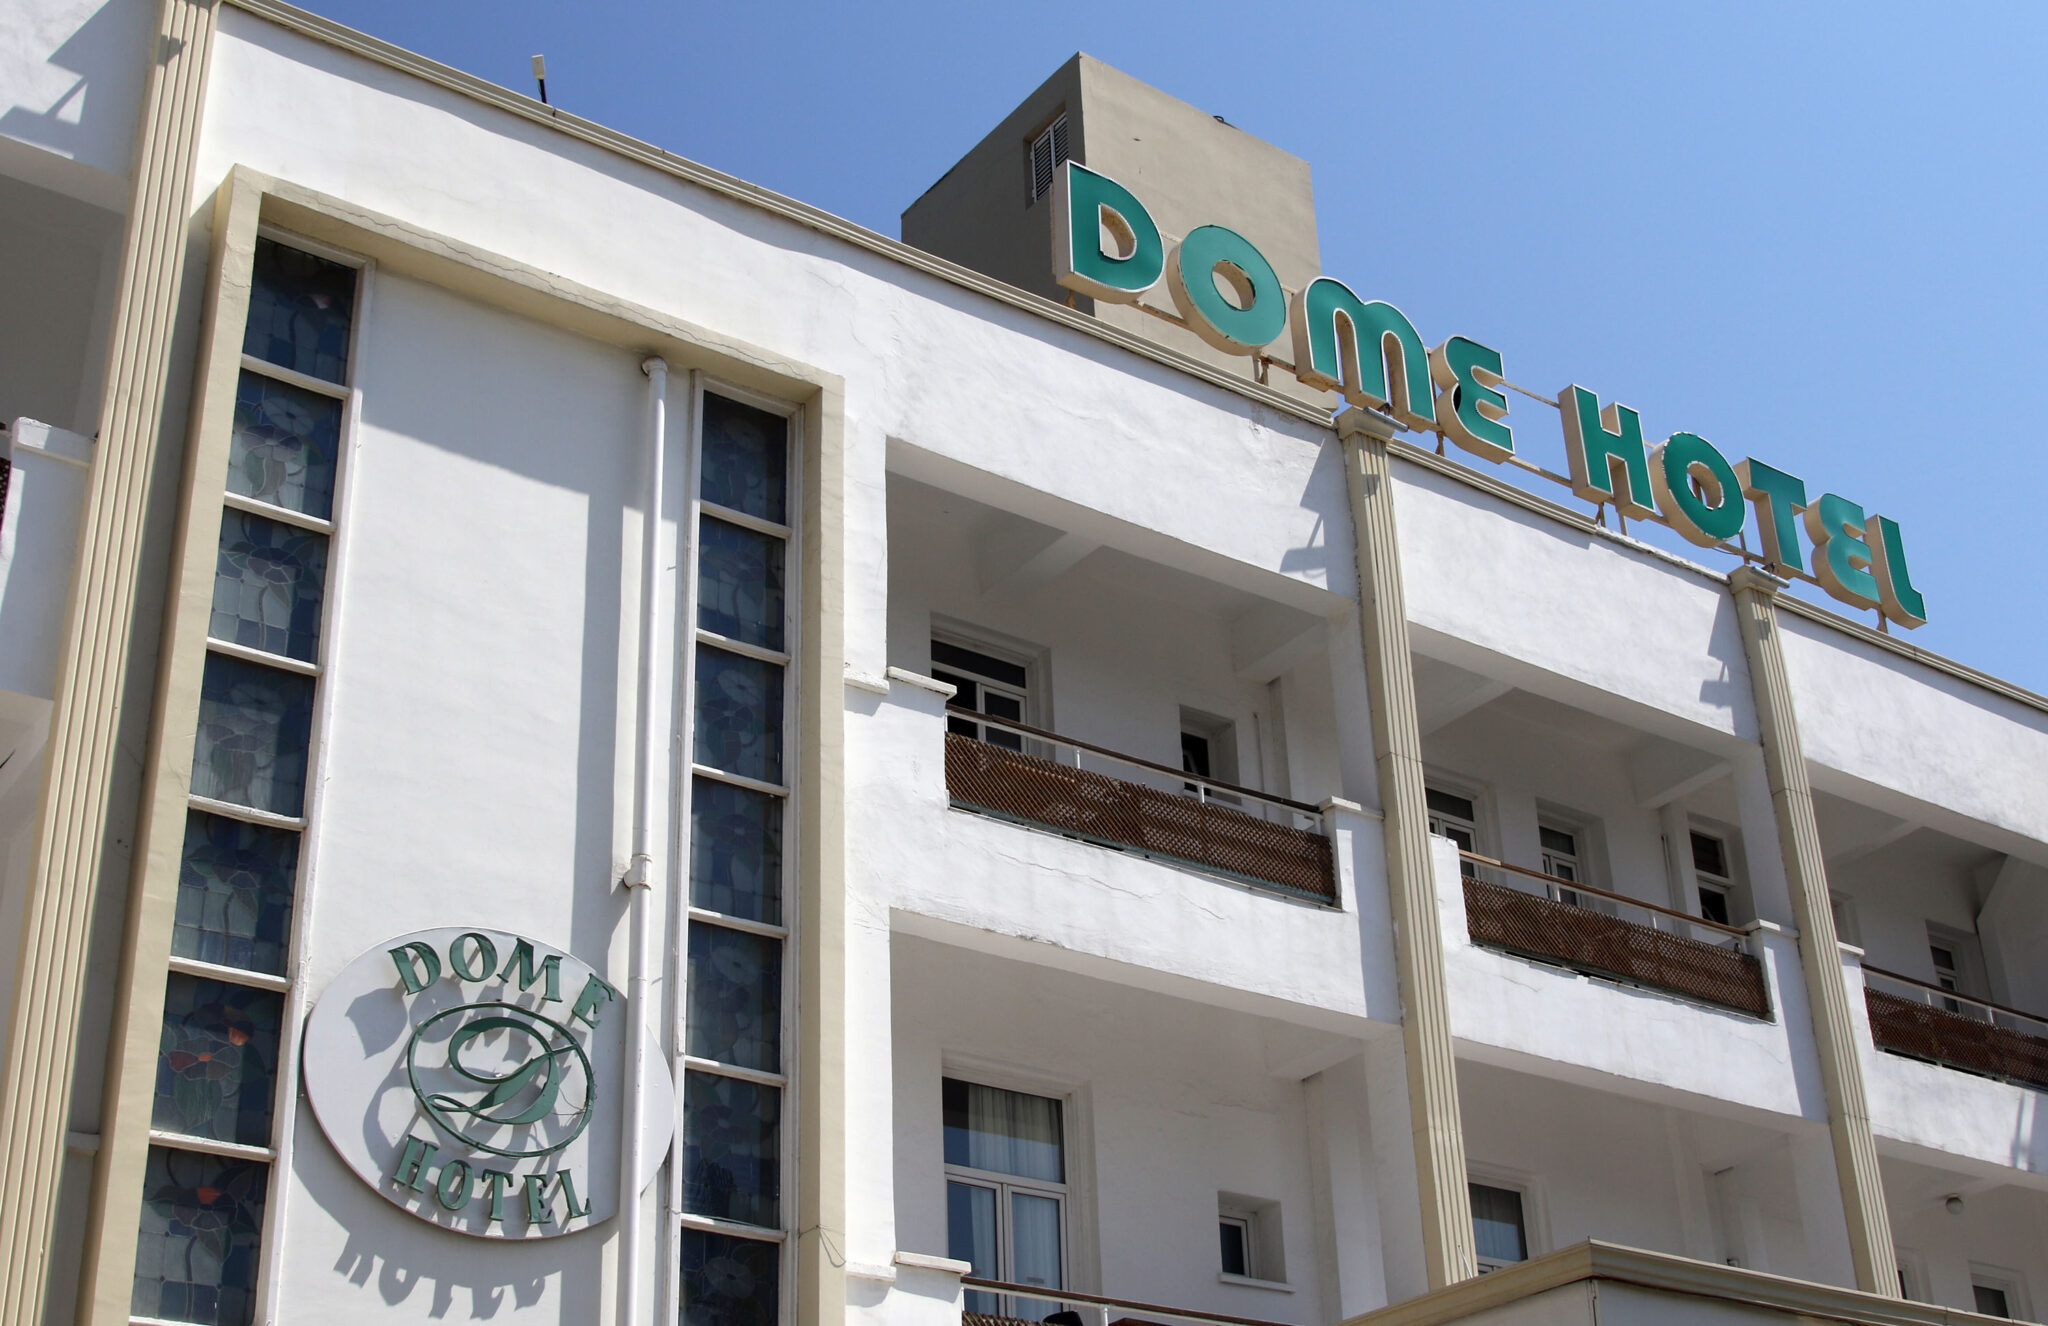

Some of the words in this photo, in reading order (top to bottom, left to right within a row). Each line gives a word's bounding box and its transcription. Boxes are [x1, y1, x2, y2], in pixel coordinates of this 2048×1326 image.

[1053, 159, 1516, 464] DOME
[1559, 383, 1928, 630] HOTEL
[388, 932, 616, 1029] DOME
[393, 1135, 592, 1225] HOTEL
